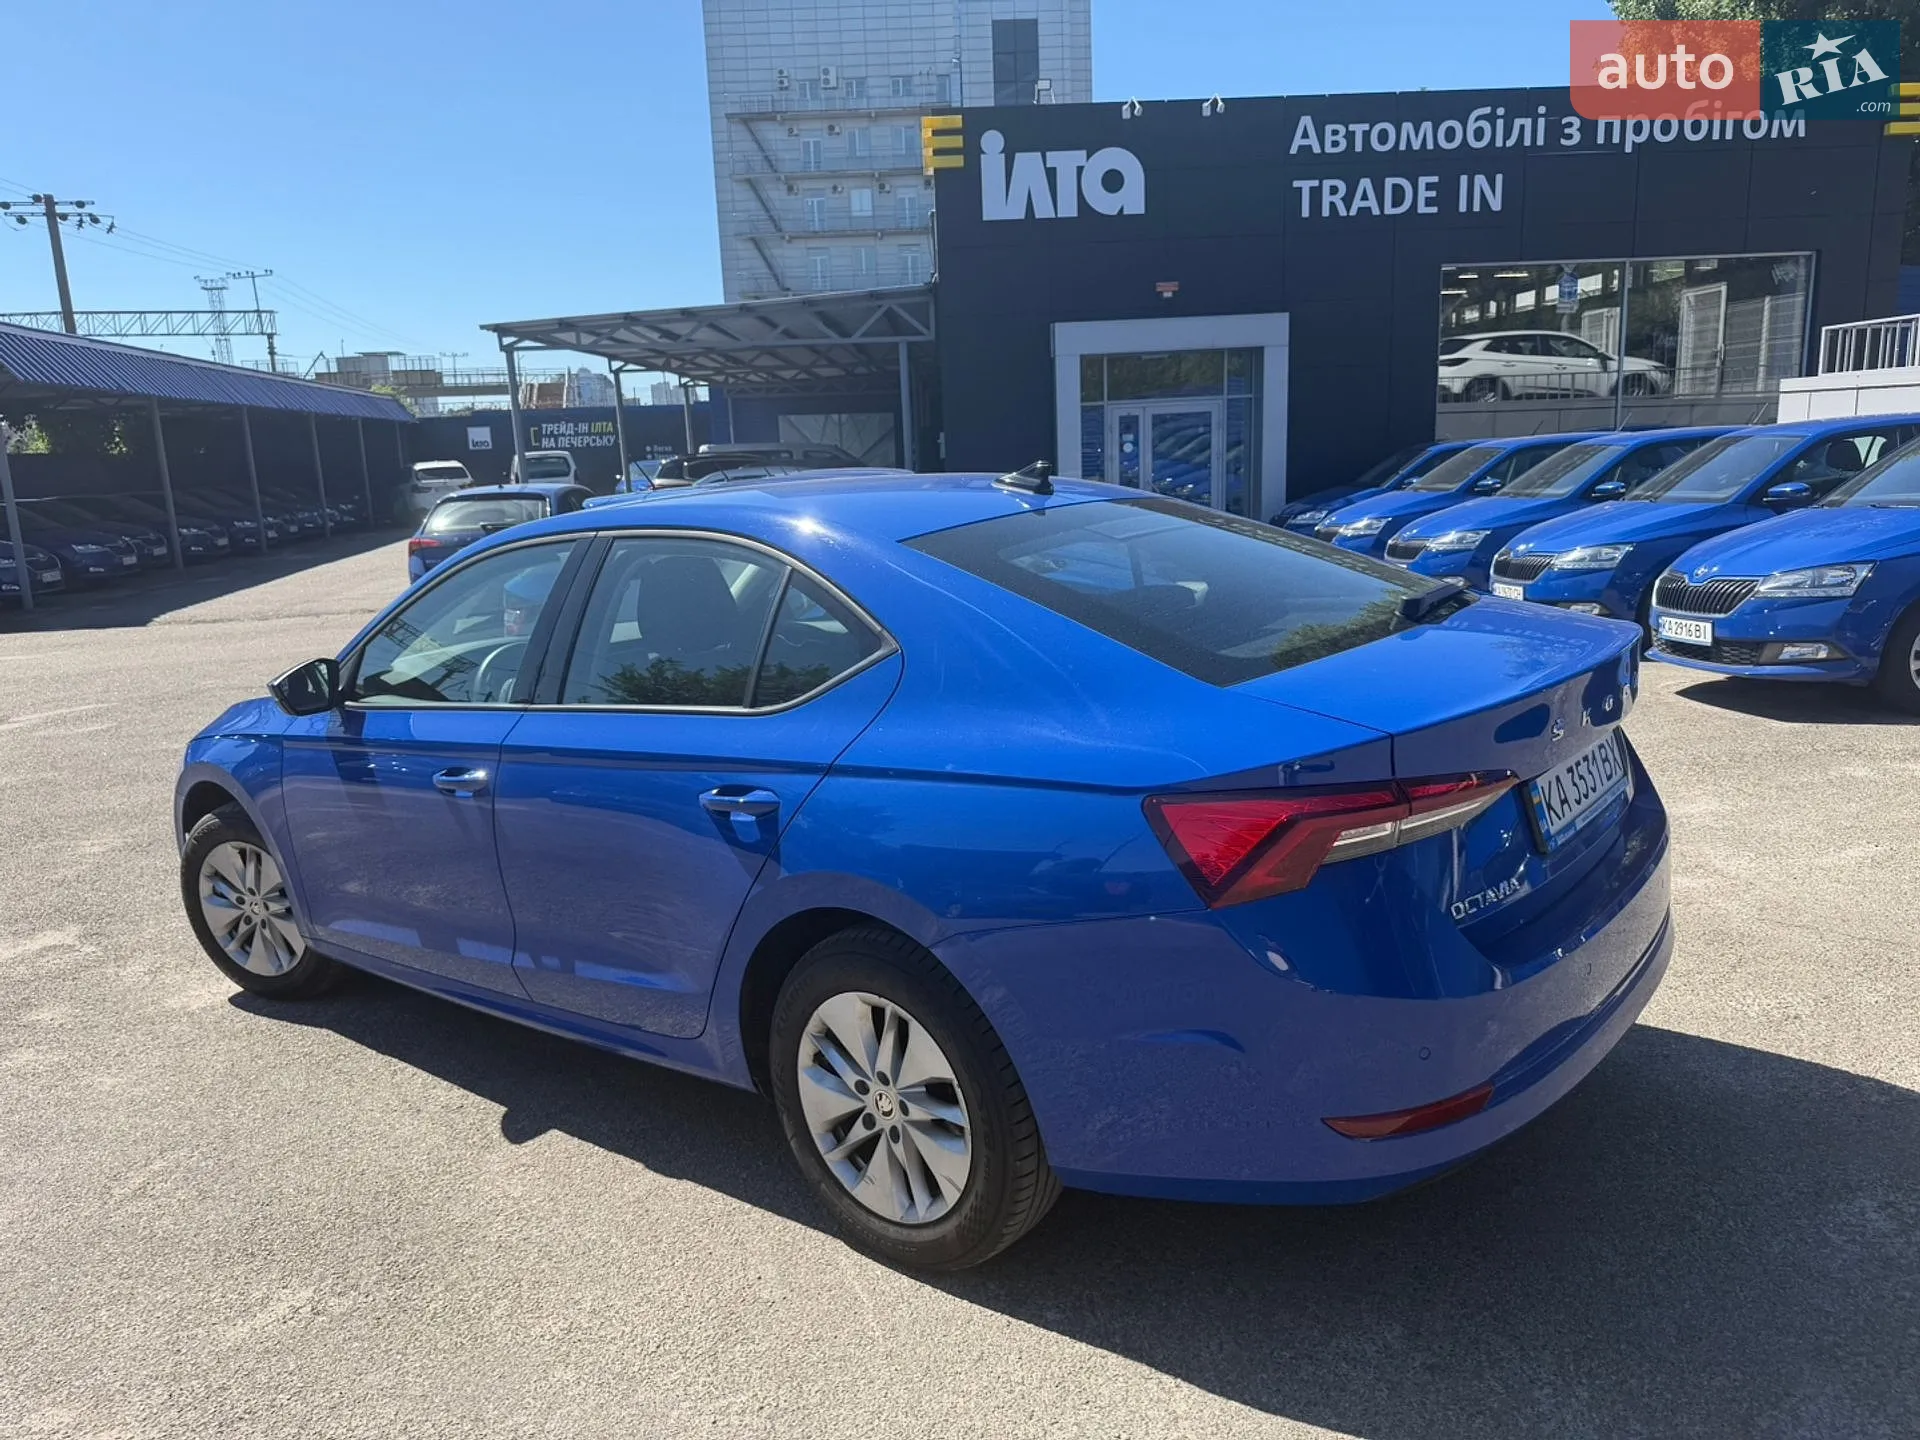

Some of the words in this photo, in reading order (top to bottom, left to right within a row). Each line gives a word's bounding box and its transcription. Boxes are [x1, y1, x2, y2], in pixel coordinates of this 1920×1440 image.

[1289, 105, 1547, 154] Автомобілі
[1560, 116, 1582, 147] з
[1596, 100, 1806, 153] пробігом
[1292, 175, 1440, 218] TRADE
[1458, 173, 1504, 213] IN
[541, 421, 589, 435] ТРЕЙД-ІН
[541, 436, 556, 448] НА
[558, 435, 616, 448] ПЕЧЕРСЬКУ
[1541, 774, 1572, 827] KA
[1566, 750, 1604, 806] 3531
[1598, 735, 1624, 782] BX
[1450, 878, 1521, 919] OCTAVIA
